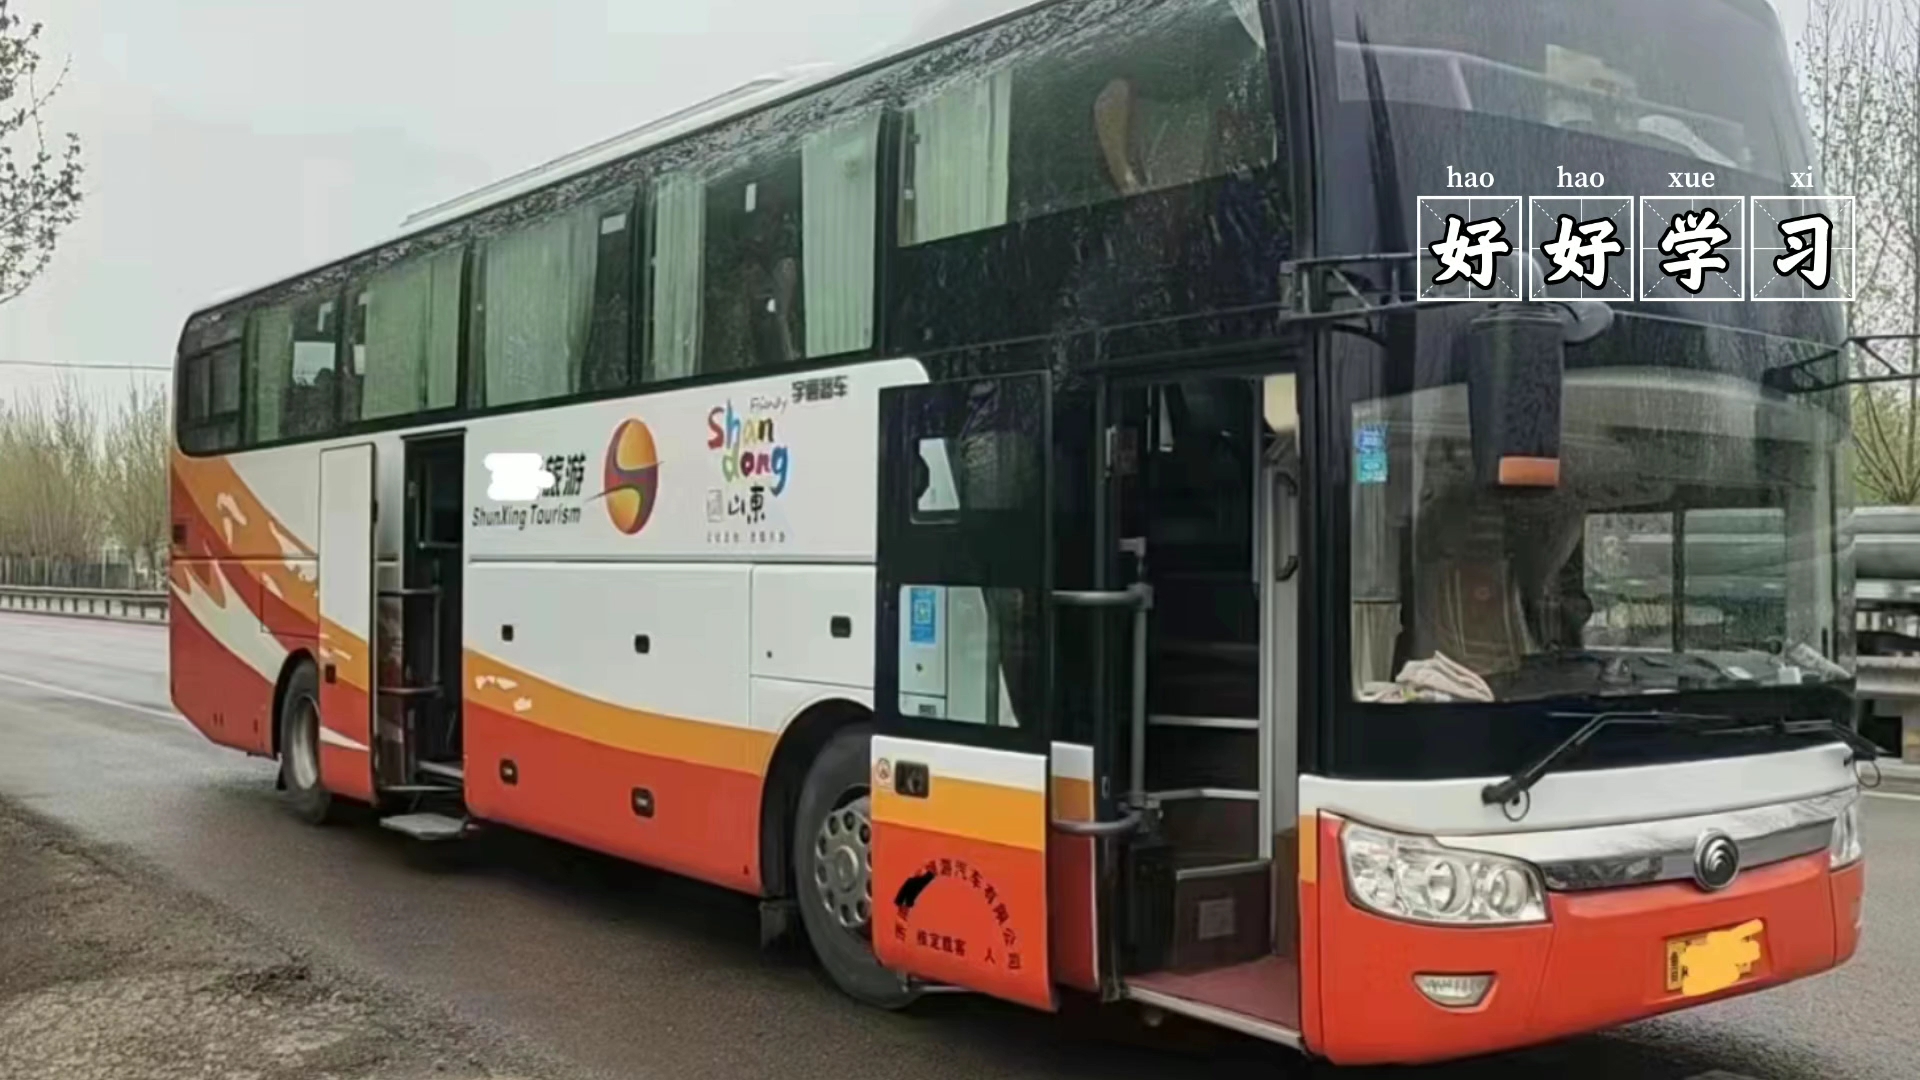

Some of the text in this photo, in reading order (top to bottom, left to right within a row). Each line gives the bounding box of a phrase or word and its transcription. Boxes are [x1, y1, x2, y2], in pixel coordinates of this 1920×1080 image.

[707, 398, 774, 450] Shan
[722, 443, 789, 497] dong
[472, 503, 581, 531] ShunXing Tourism
